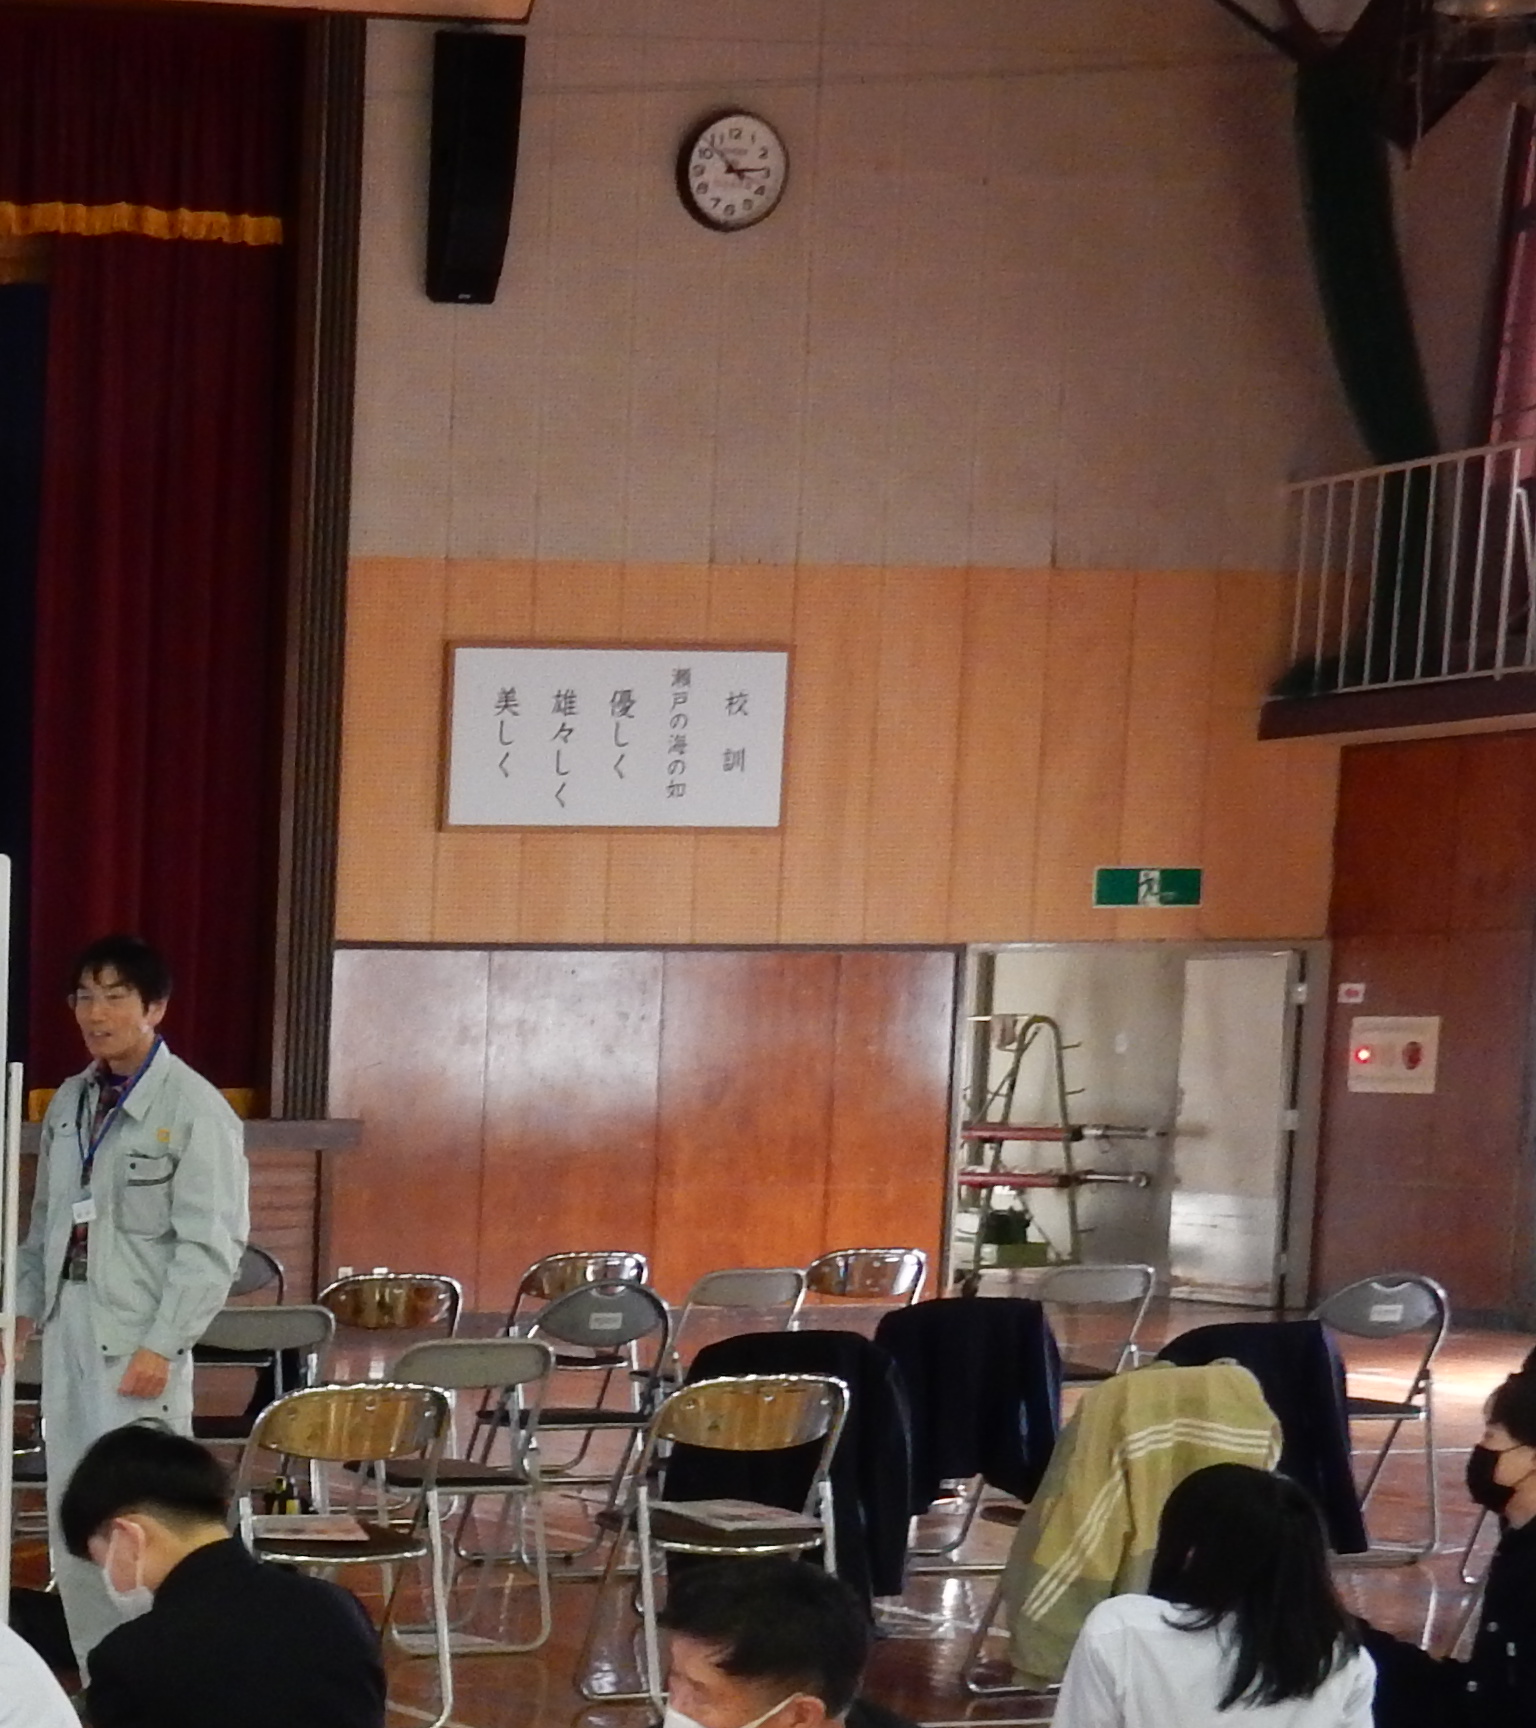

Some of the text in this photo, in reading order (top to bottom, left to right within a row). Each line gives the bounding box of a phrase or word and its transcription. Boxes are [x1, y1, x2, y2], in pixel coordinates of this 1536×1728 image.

[493, 686, 520, 778] 美しく
[550, 689, 578, 808] 雄々しく
[609, 688, 637, 780] 優しく
[722, 690, 750, 774] 校訓
